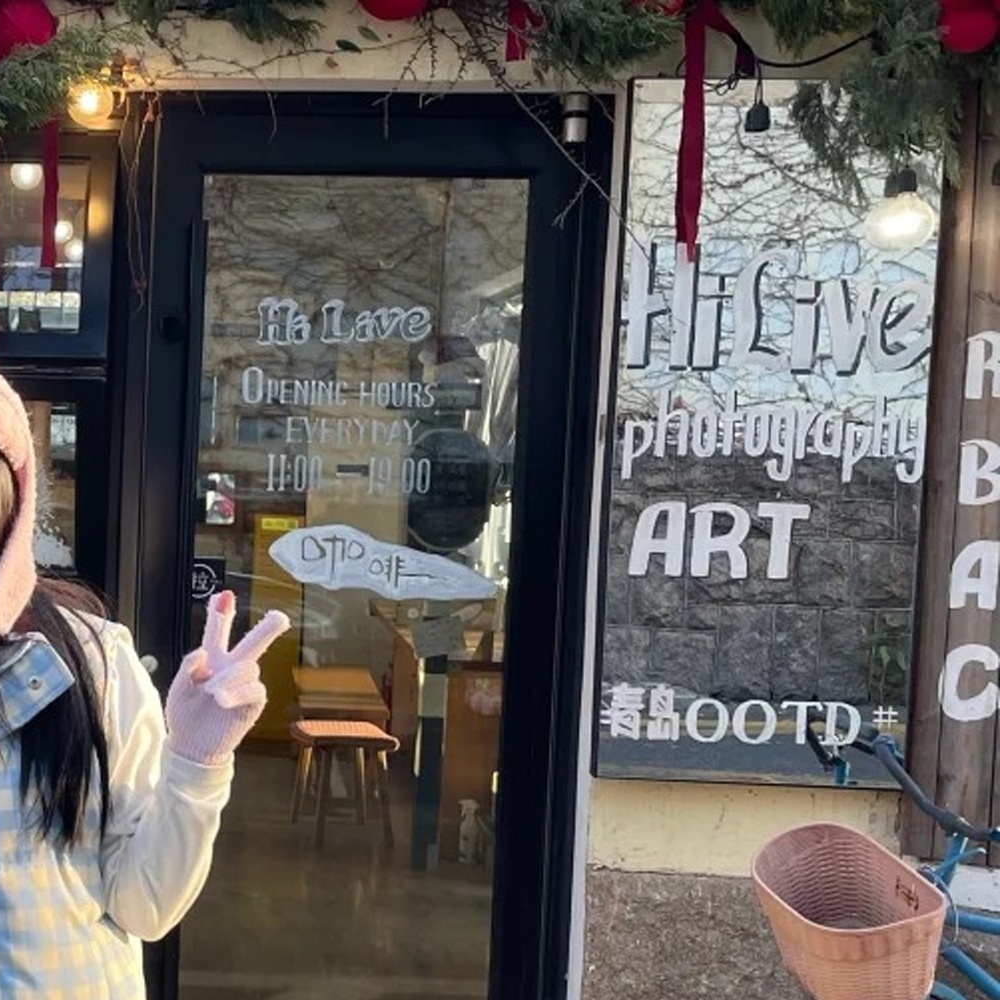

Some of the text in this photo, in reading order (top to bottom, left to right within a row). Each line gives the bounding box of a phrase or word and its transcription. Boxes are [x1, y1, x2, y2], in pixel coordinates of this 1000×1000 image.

[257, 297, 432, 345] Hi Live
[359, 381, 437, 408] HOURS
[286, 416, 420, 445] EVERYDAY
[621, 390, 926, 484] photography
[266, 453, 323, 492] 11:00
[368, 456, 431, 494] 1900
[628, 501, 810, 579] ART
